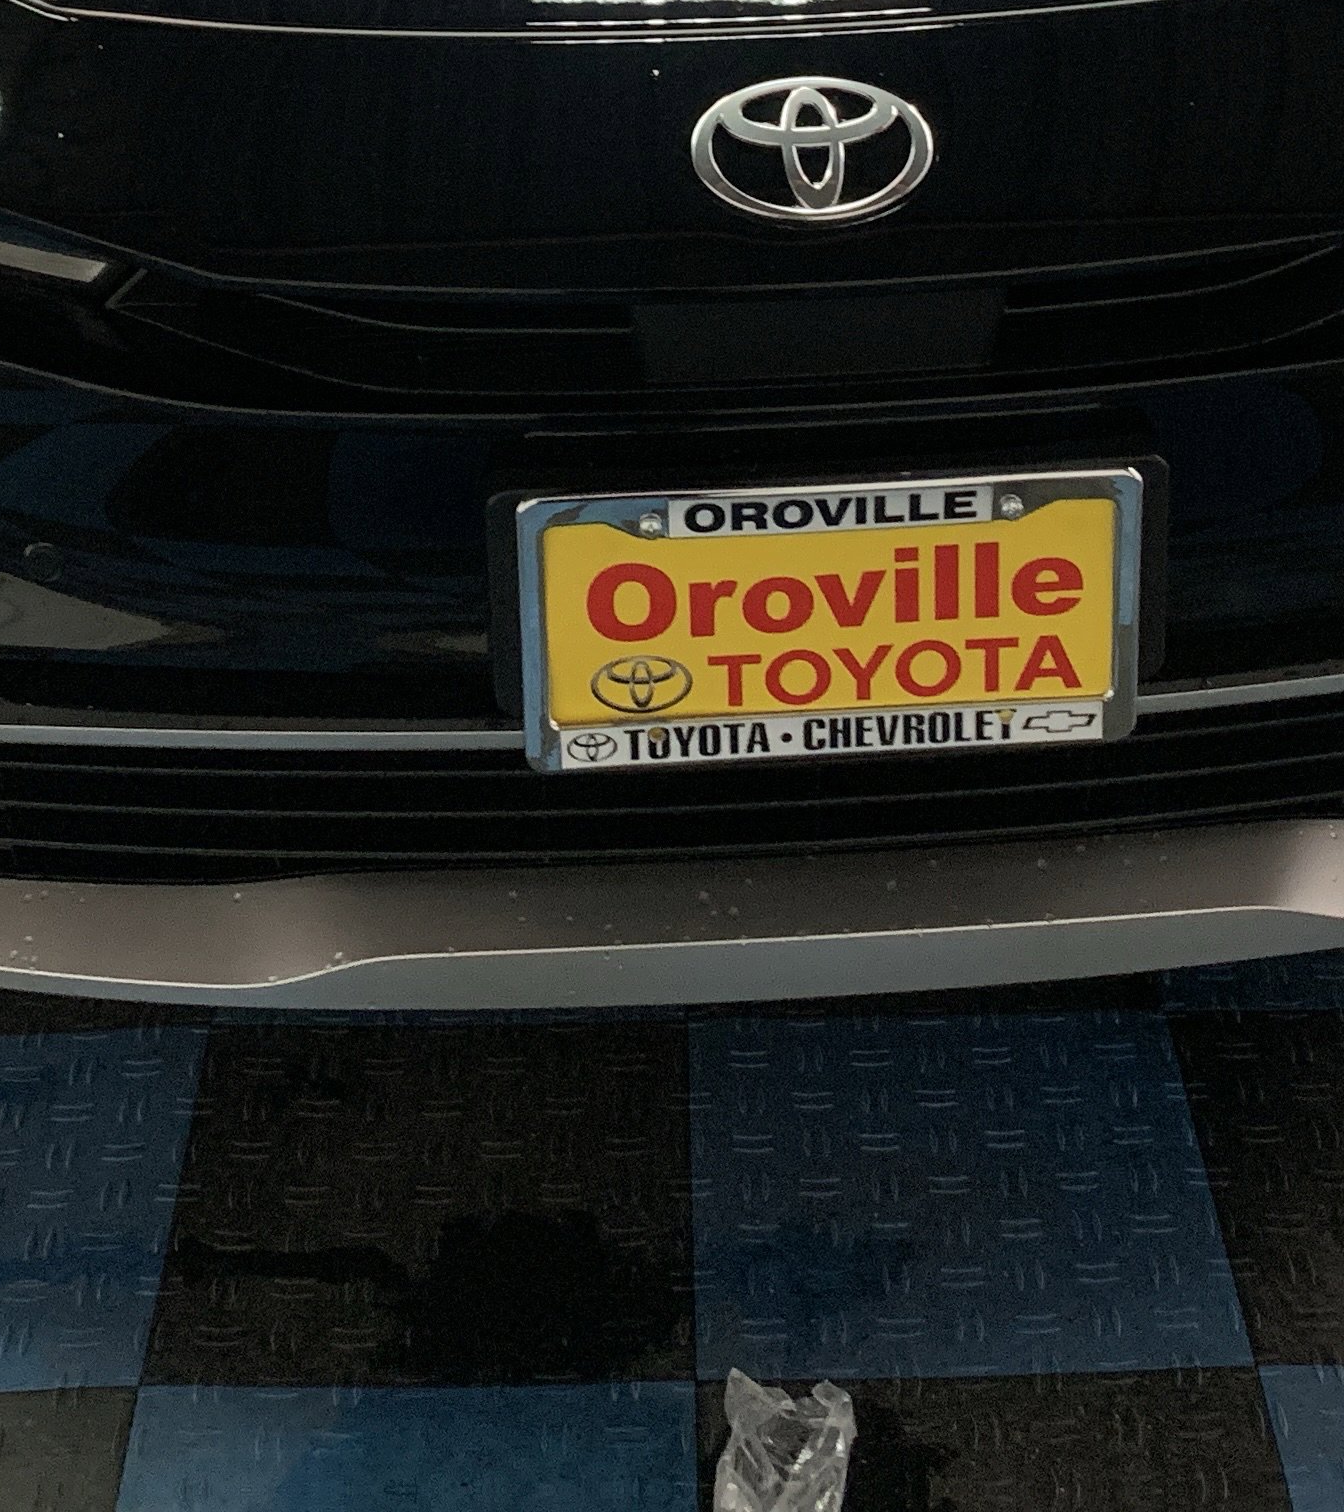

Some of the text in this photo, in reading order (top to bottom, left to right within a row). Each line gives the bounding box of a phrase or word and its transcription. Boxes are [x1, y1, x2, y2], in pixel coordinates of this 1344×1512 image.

[683, 491, 978, 534] OROVILLE
[586, 541, 1084, 643] Oroville
[708, 635, 1083, 707] TOYOTA
[625, 708, 1015, 762] TOYOTA CHEVROLET
